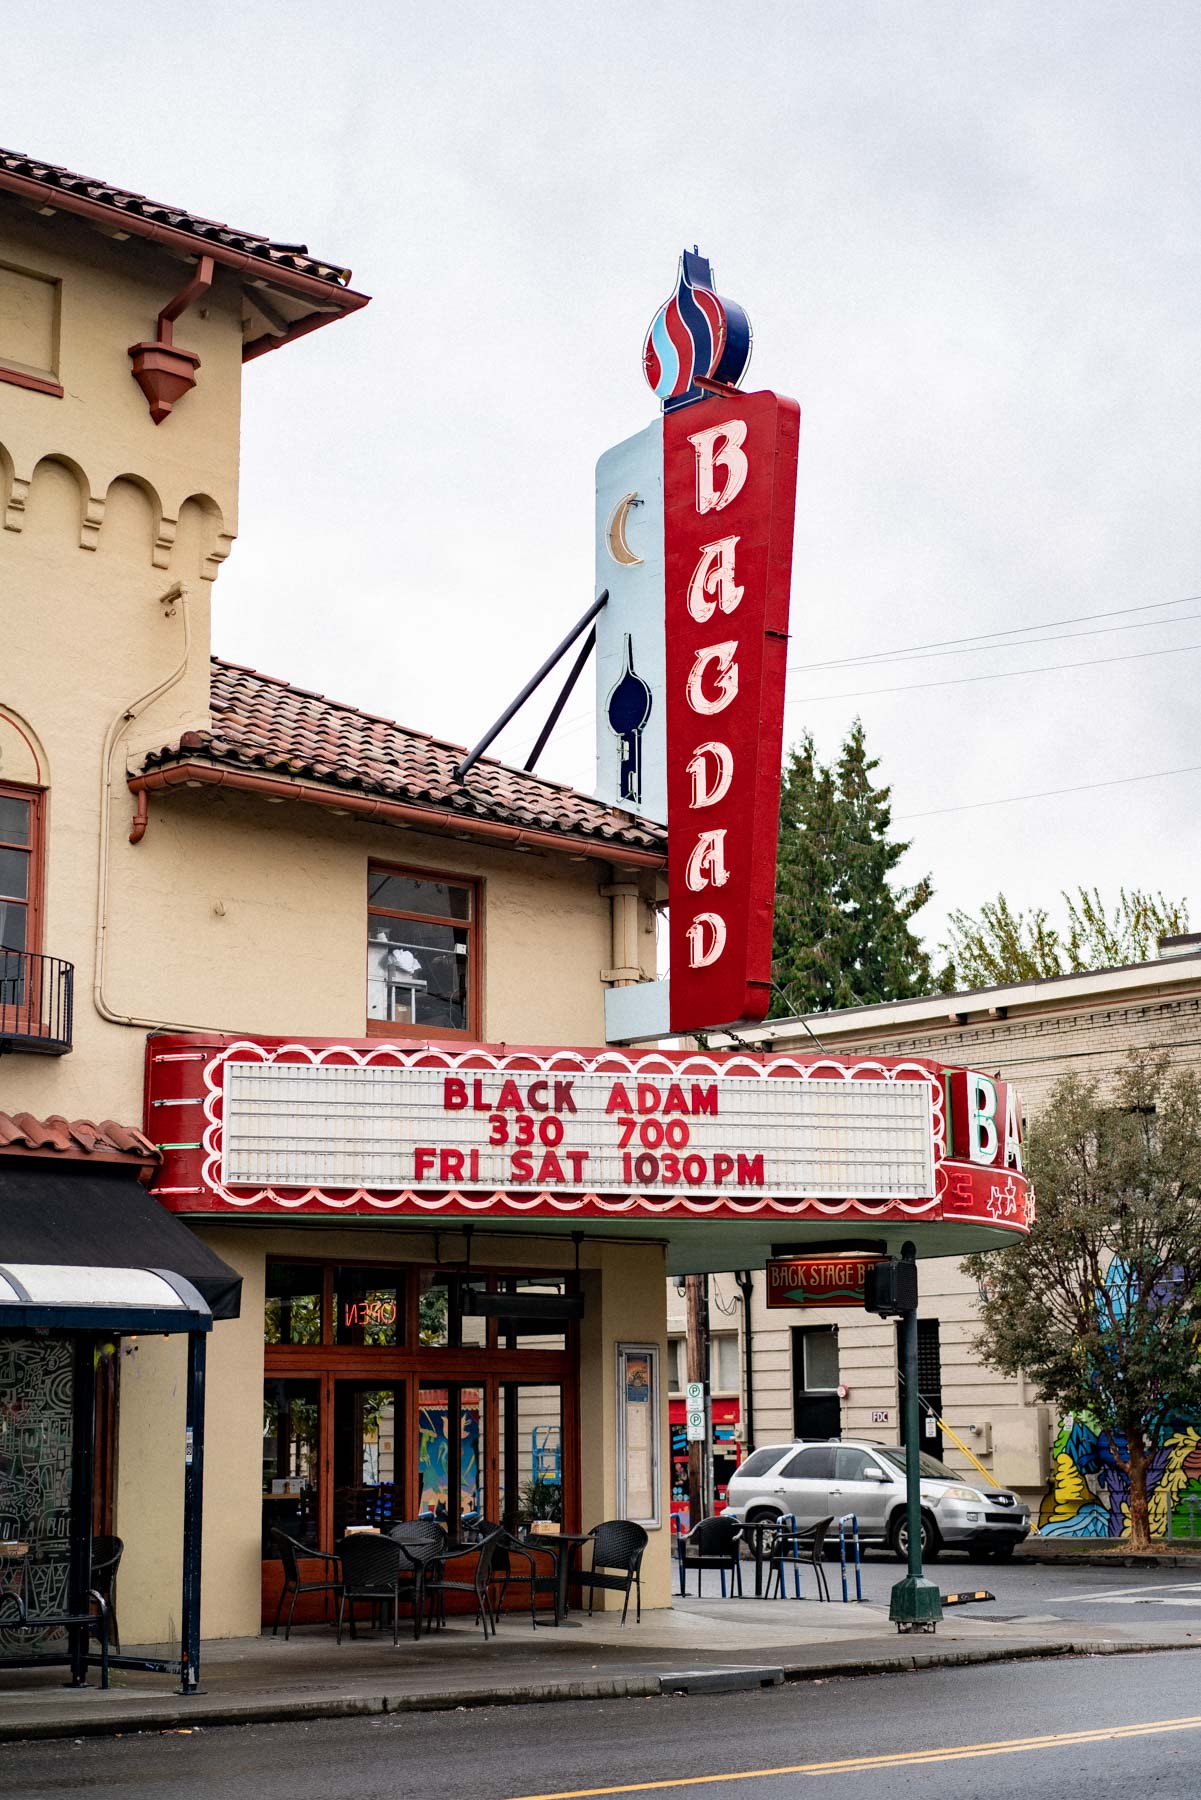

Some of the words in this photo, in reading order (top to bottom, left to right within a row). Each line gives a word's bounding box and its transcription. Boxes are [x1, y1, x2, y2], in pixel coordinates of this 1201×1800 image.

[686, 419, 749, 968] BAGDAD
[443, 1077, 578, 1114] BLACK
[605, 1082, 719, 1116] ADAM
[488, 1114, 565, 1147] 330
[617, 1117, 690, 1150] 700
[414, 1147, 479, 1181] FRI
[511, 1150, 589, 1184] SAT
[771, 1265, 807, 1286] BACK
[810, 1264, 854, 1286] STAGE
[872, 1411, 888, 1422] FDC
